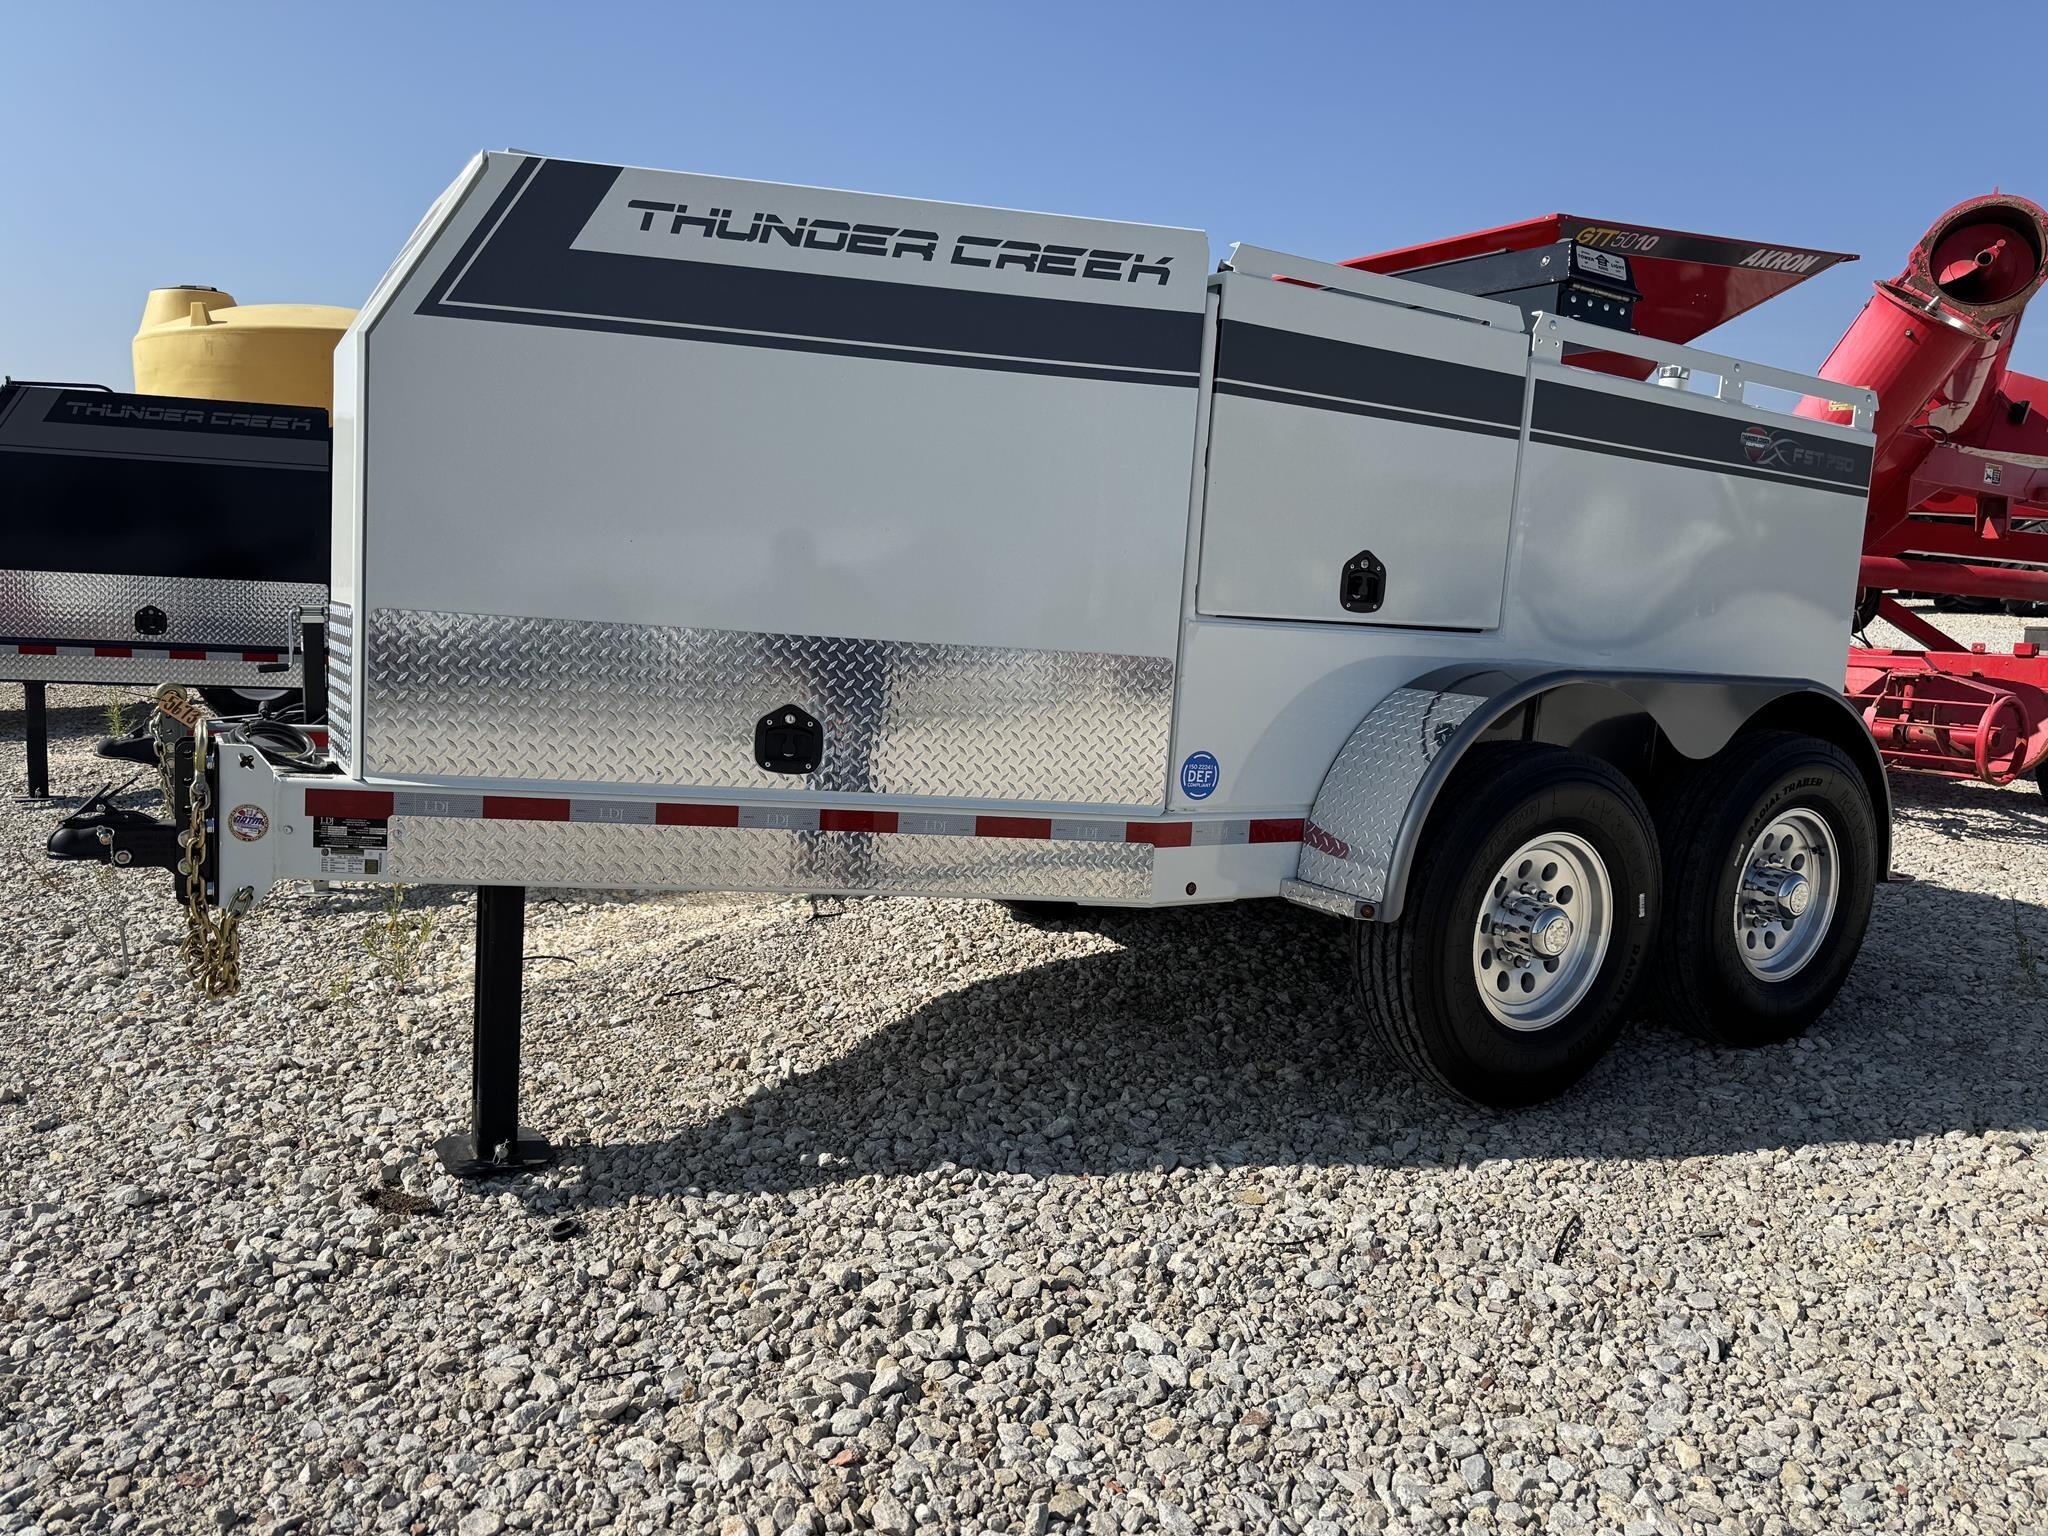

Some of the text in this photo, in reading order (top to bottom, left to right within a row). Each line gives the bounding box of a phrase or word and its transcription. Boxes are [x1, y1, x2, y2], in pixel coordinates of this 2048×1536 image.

[627, 199, 1176, 286] THUNDER CREEK
[1738, 248, 1821, 273] AKRON
[65, 401, 312, 431] THUNDER CREEK
[1188, 770, 1213, 782] DEF
[1782, 776, 1824, 797] TRAILER
